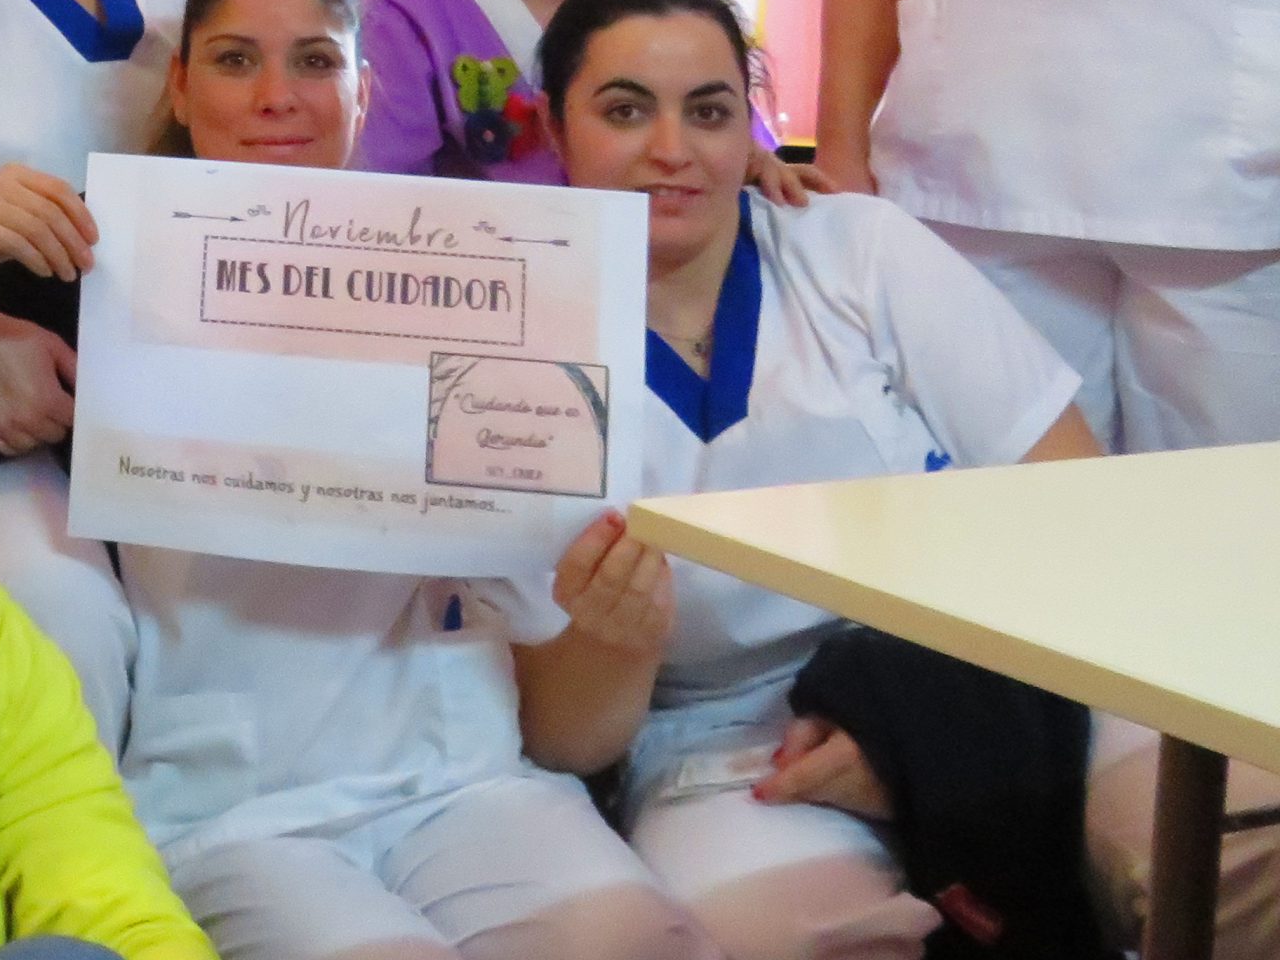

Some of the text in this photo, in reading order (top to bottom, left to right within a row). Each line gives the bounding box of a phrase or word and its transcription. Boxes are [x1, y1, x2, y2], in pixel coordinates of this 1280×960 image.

[282, 198, 460, 250] Noviembre
[216, 258, 512, 312] MES DEL CUIDADOR
[119, 455, 186, 483] Nosotras
[191, 472, 218, 486] nos
[223, 471, 295, 494] cuidamos
[298, 483, 311, 503] y
[316, 485, 385, 503] nosotras
[390, 491, 418, 505] nos
